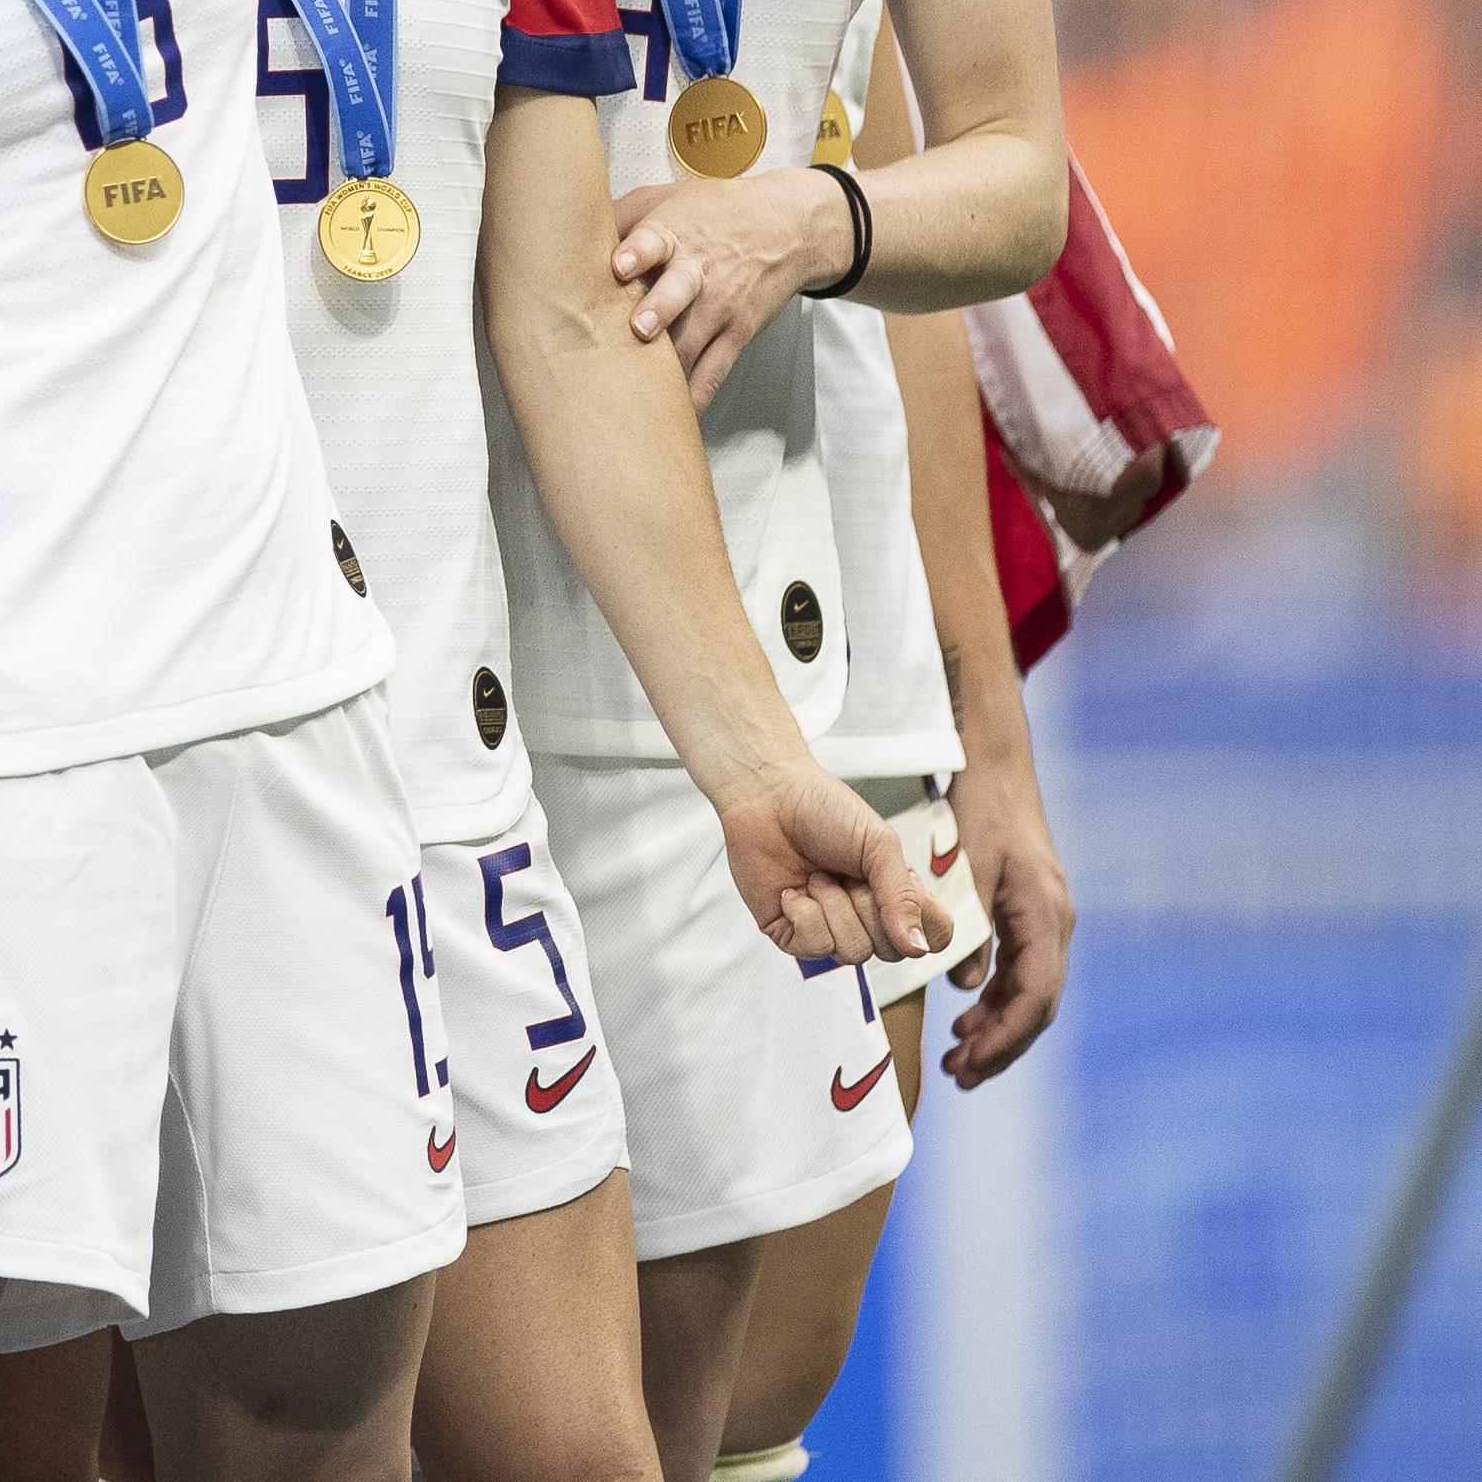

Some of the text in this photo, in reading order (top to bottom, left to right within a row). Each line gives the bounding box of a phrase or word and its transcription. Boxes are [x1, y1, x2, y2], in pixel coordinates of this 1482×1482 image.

[684, 111, 749, 146] FIFA
[103, 177, 167, 210] FIFA
[477, 843, 587, 1050] 5
